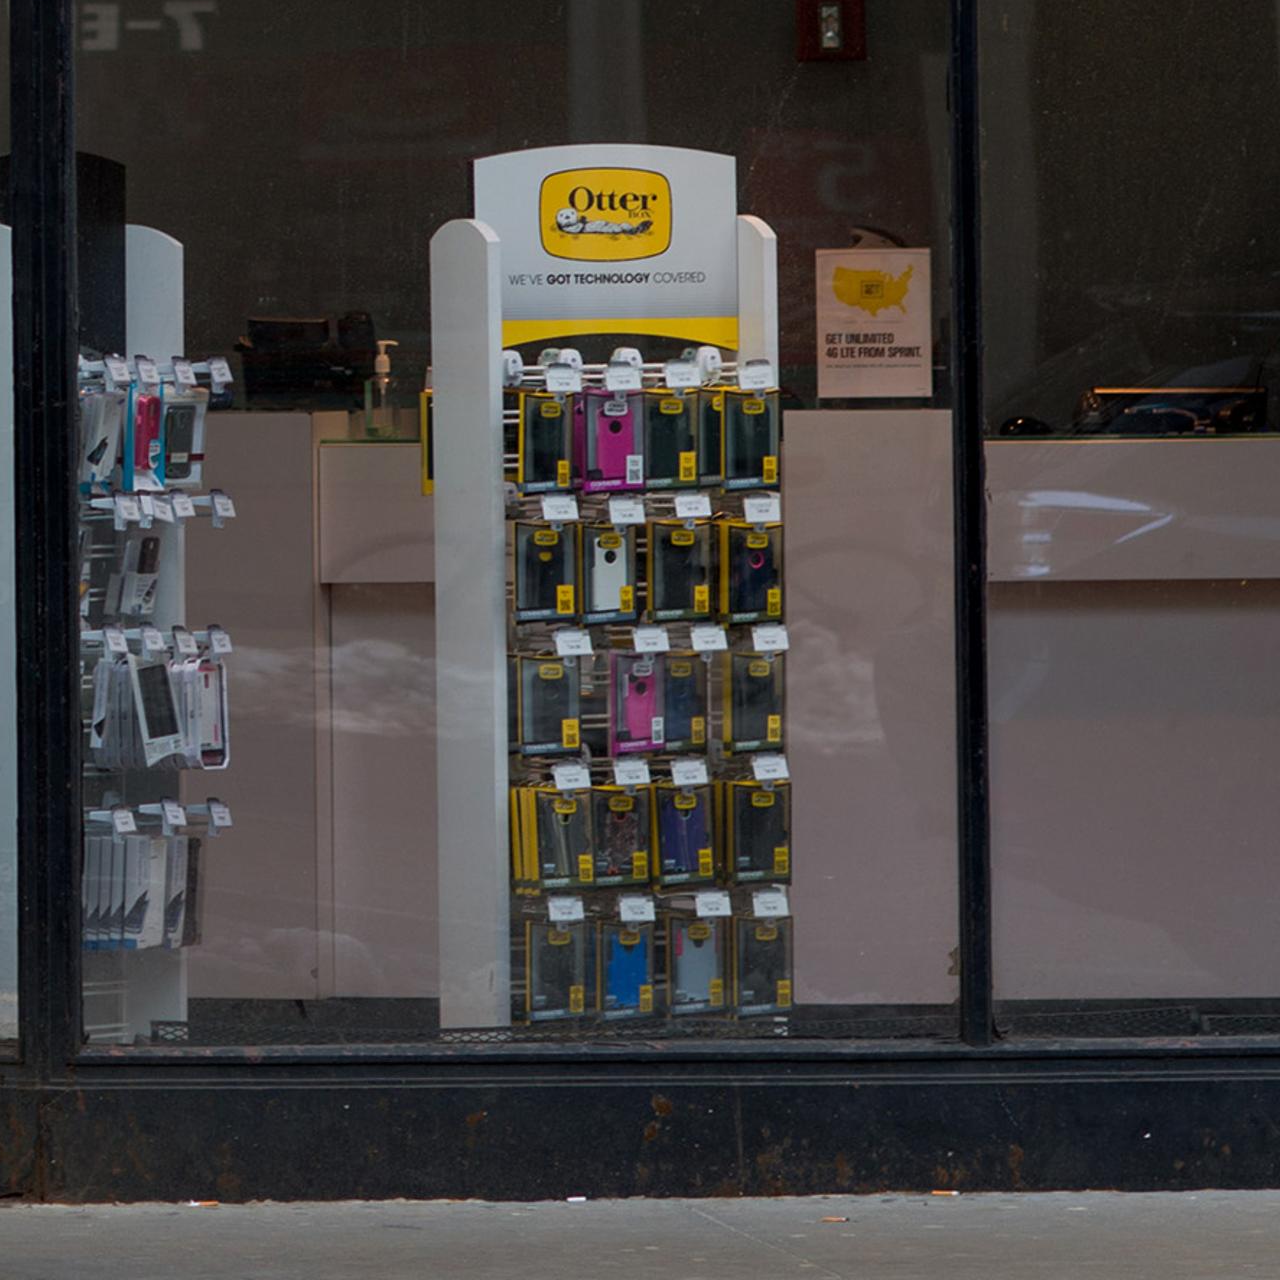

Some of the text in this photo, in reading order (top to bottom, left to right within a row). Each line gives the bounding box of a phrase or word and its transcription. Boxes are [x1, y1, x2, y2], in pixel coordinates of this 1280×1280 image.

[568, 185, 658, 212] Otter
[508, 271, 707, 286] WE'VE GOT TECHNOLOGY COVERED
[825, 332, 895, 345] GET UNLIMITED
[825, 346, 923, 359] 4G LTE FROM SPRINT.
